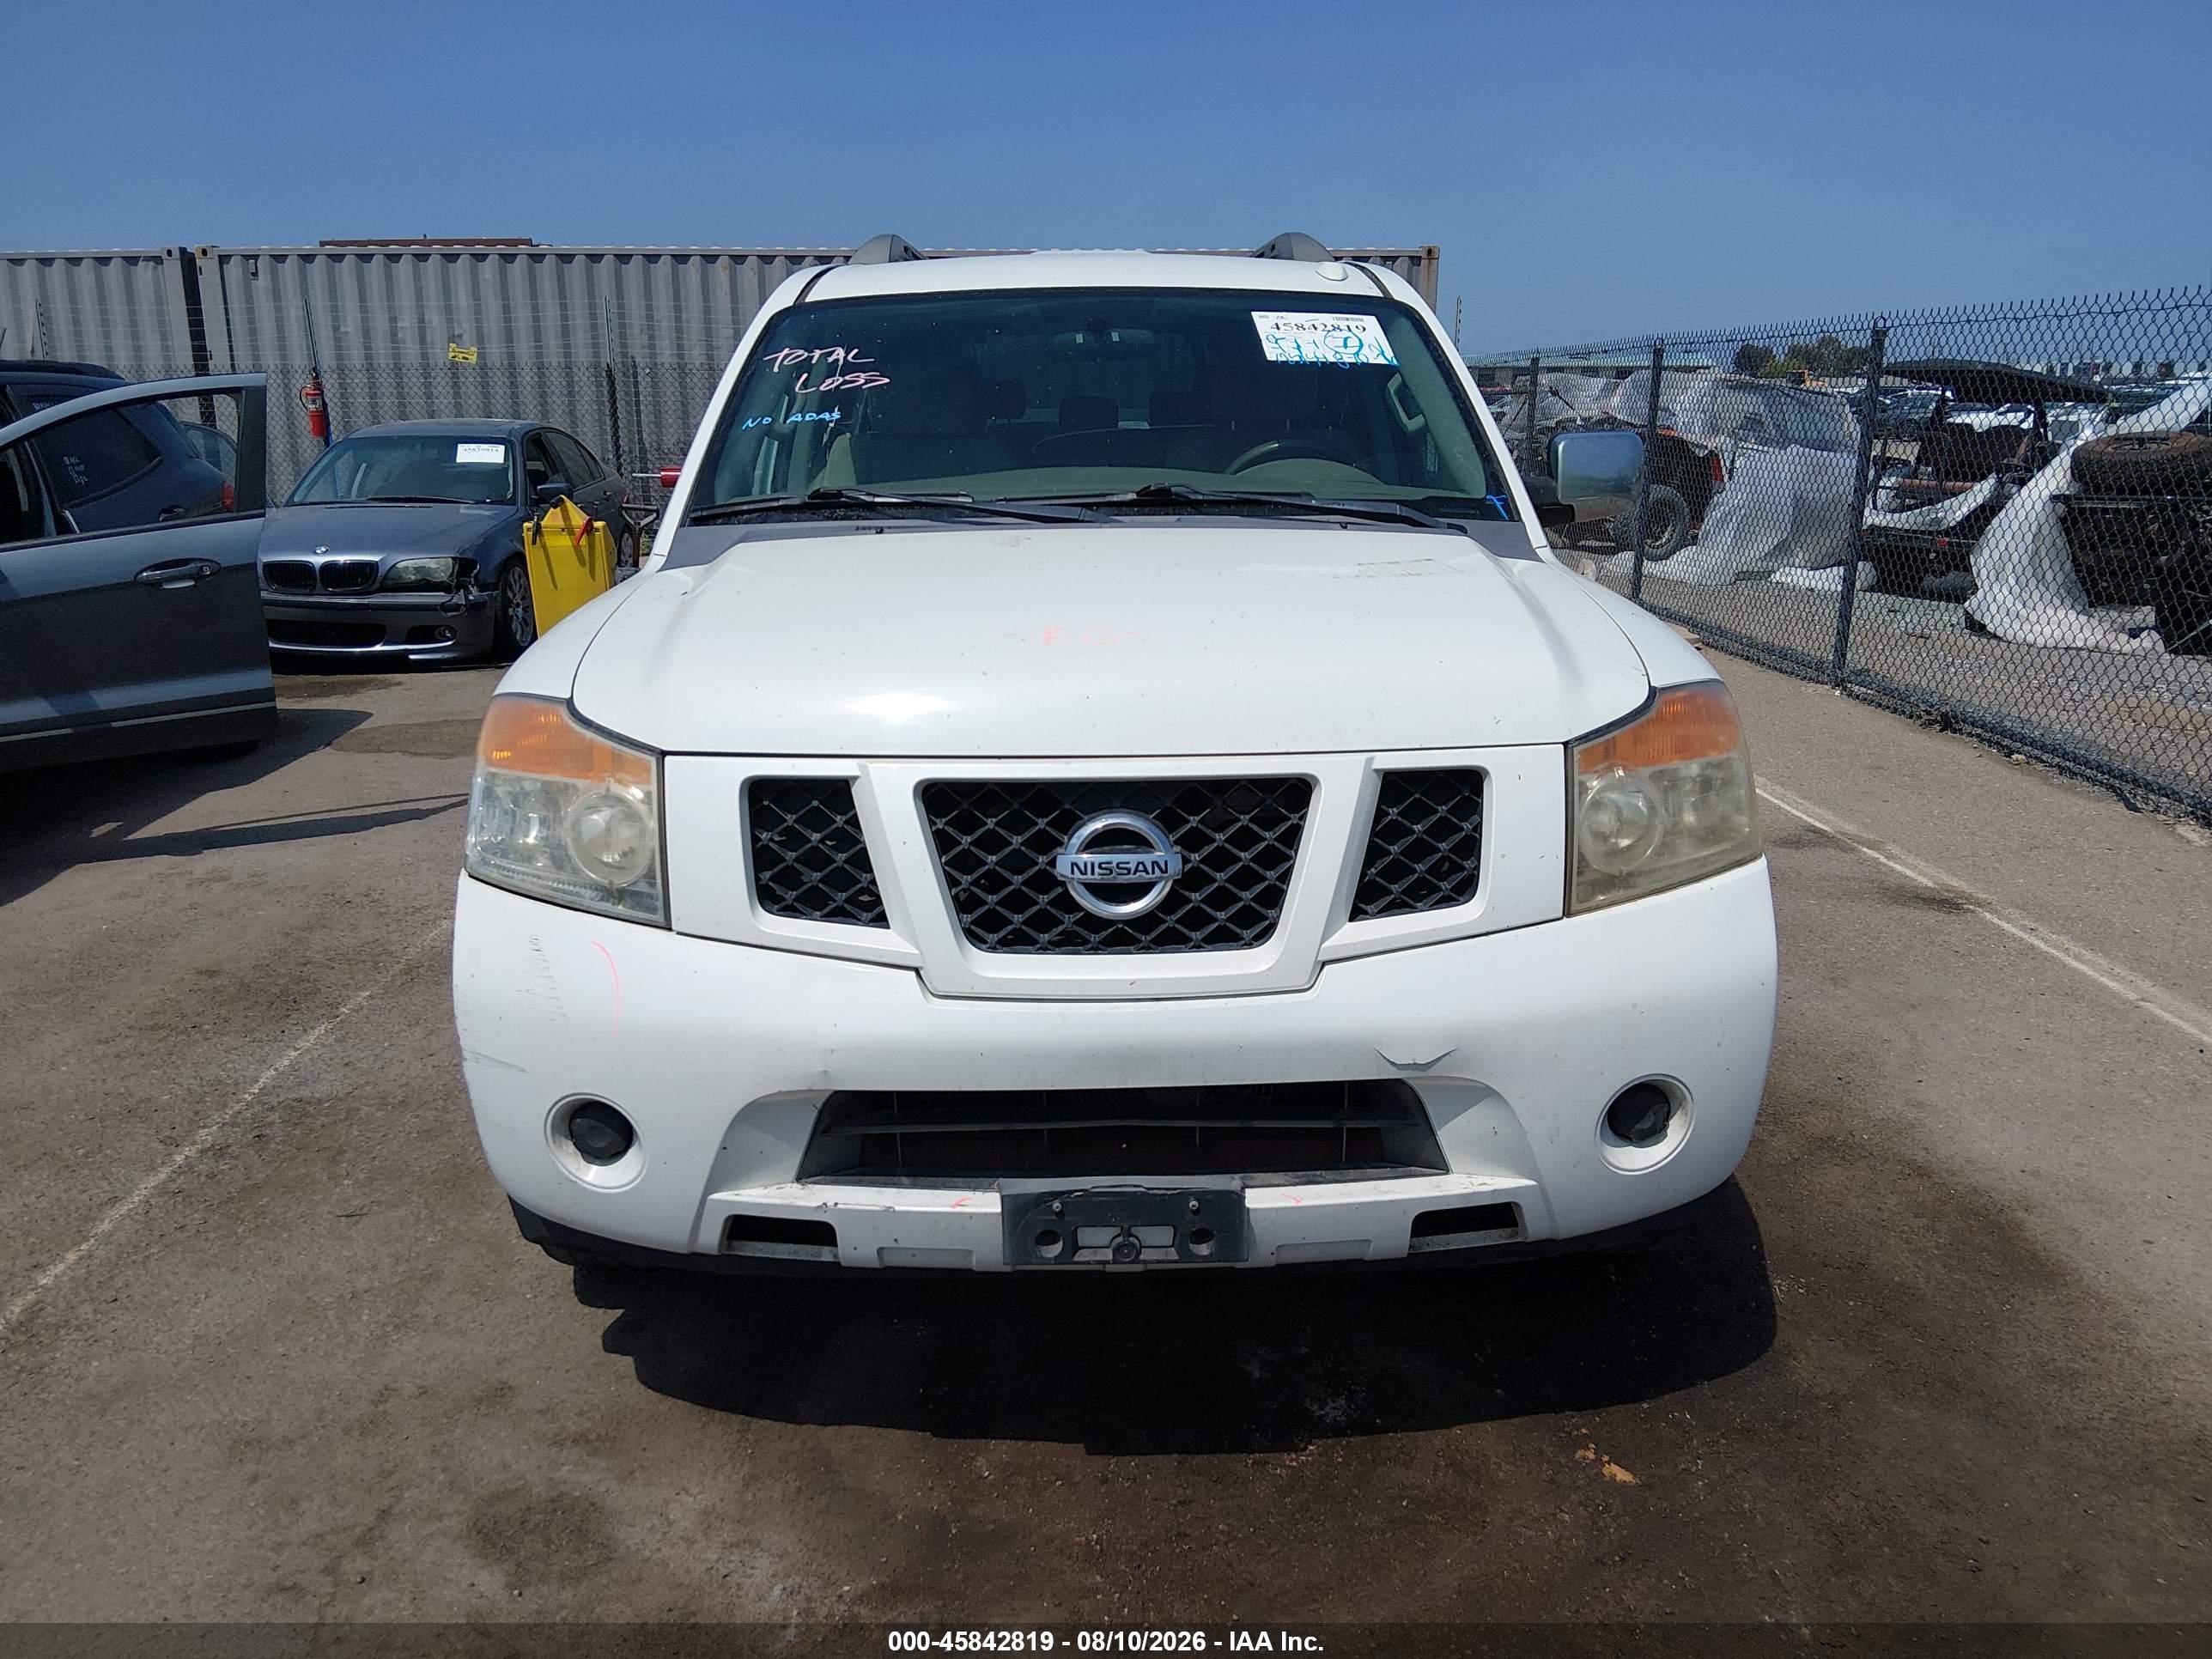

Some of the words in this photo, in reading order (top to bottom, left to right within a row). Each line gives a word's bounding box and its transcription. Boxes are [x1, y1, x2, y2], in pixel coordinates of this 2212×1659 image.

[1270, 322, 1367, 333] 45842819
[763, 346, 875, 372] TOTAL
[794, 372, 890, 393] LOSS
[742, 416, 773, 430] NO
[1070, 860, 1169, 877] NISSAN
